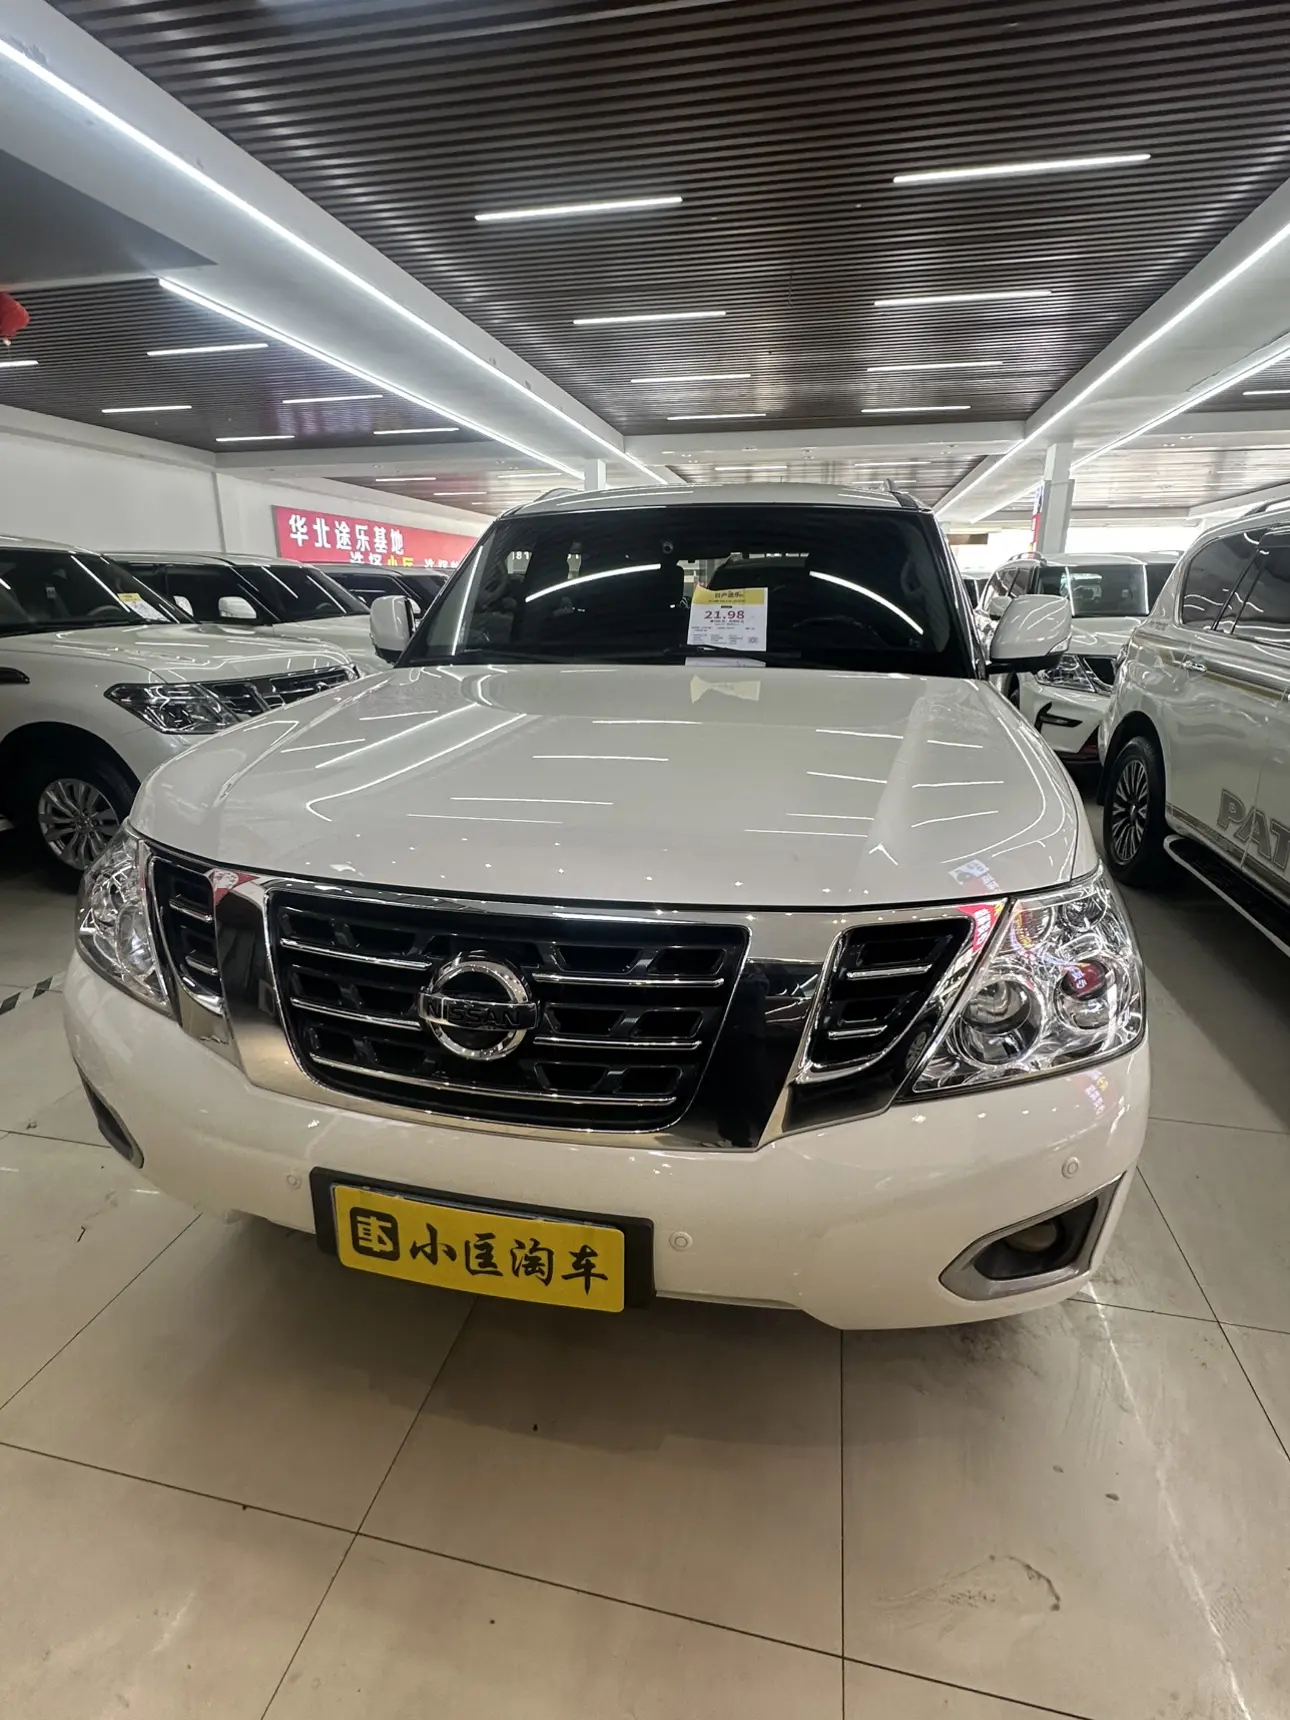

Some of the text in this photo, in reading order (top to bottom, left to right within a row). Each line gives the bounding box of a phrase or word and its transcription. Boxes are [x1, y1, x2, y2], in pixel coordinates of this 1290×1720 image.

[288, 513, 404, 556] 华北途乐基地
[704, 610, 745, 620] 21.98
[425, 1000, 521, 1028] NISSAN
[409, 1222, 608, 1295] 小匡淘车
